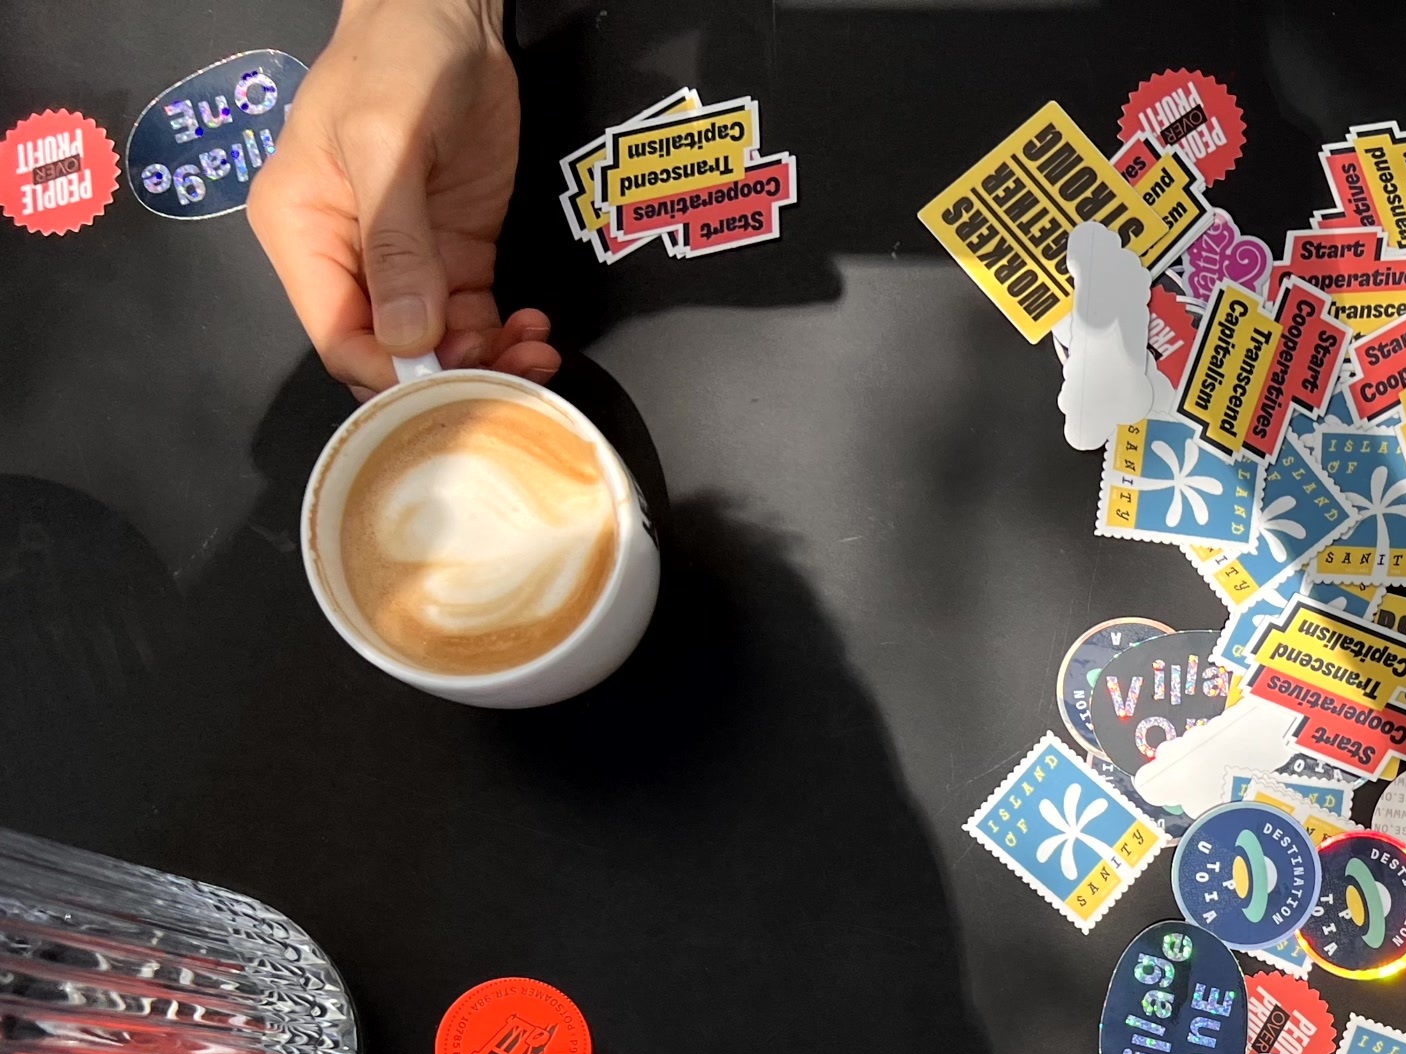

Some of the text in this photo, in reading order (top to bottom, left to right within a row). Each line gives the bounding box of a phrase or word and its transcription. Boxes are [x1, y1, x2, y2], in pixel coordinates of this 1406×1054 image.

[16, 128, 84, 173] PROFIT
[628, 121, 745, 159] Capitalism
[22, 169, 93, 215] PEOPLE
[35, 157, 79, 183] OVER
[620, 155, 734, 197] Transcend
[633, 176, 780, 221] Cooperatives
[700, 211, 764, 240] Start
[941, 196, 1060, 322] WORKERS
[1300, 240, 1365, 260] Start
[1195, 300, 1248, 411] Capitalism
[1253, 301, 1315, 439] Cooperatives
[1302, 331, 1337, 393] Start
[1220, 328, 1272, 438] Transcend
[1116, 425, 1139, 521] SANITY
[1270, 642, 1382, 700] Transcend
[1311, 727, 1376, 765] Start
[988, 755, 1057, 833] ISLAND
[1005, 818, 1028, 847] OF
[1077, 829, 1144, 907] SANITY
[1263, 823, 1304, 925] DESTINATION
[520, 986, 575, 1032] POTSDAMER
[1253, 1011, 1285, 1052] OVER
[453, 1016, 469, 1050] 10785
